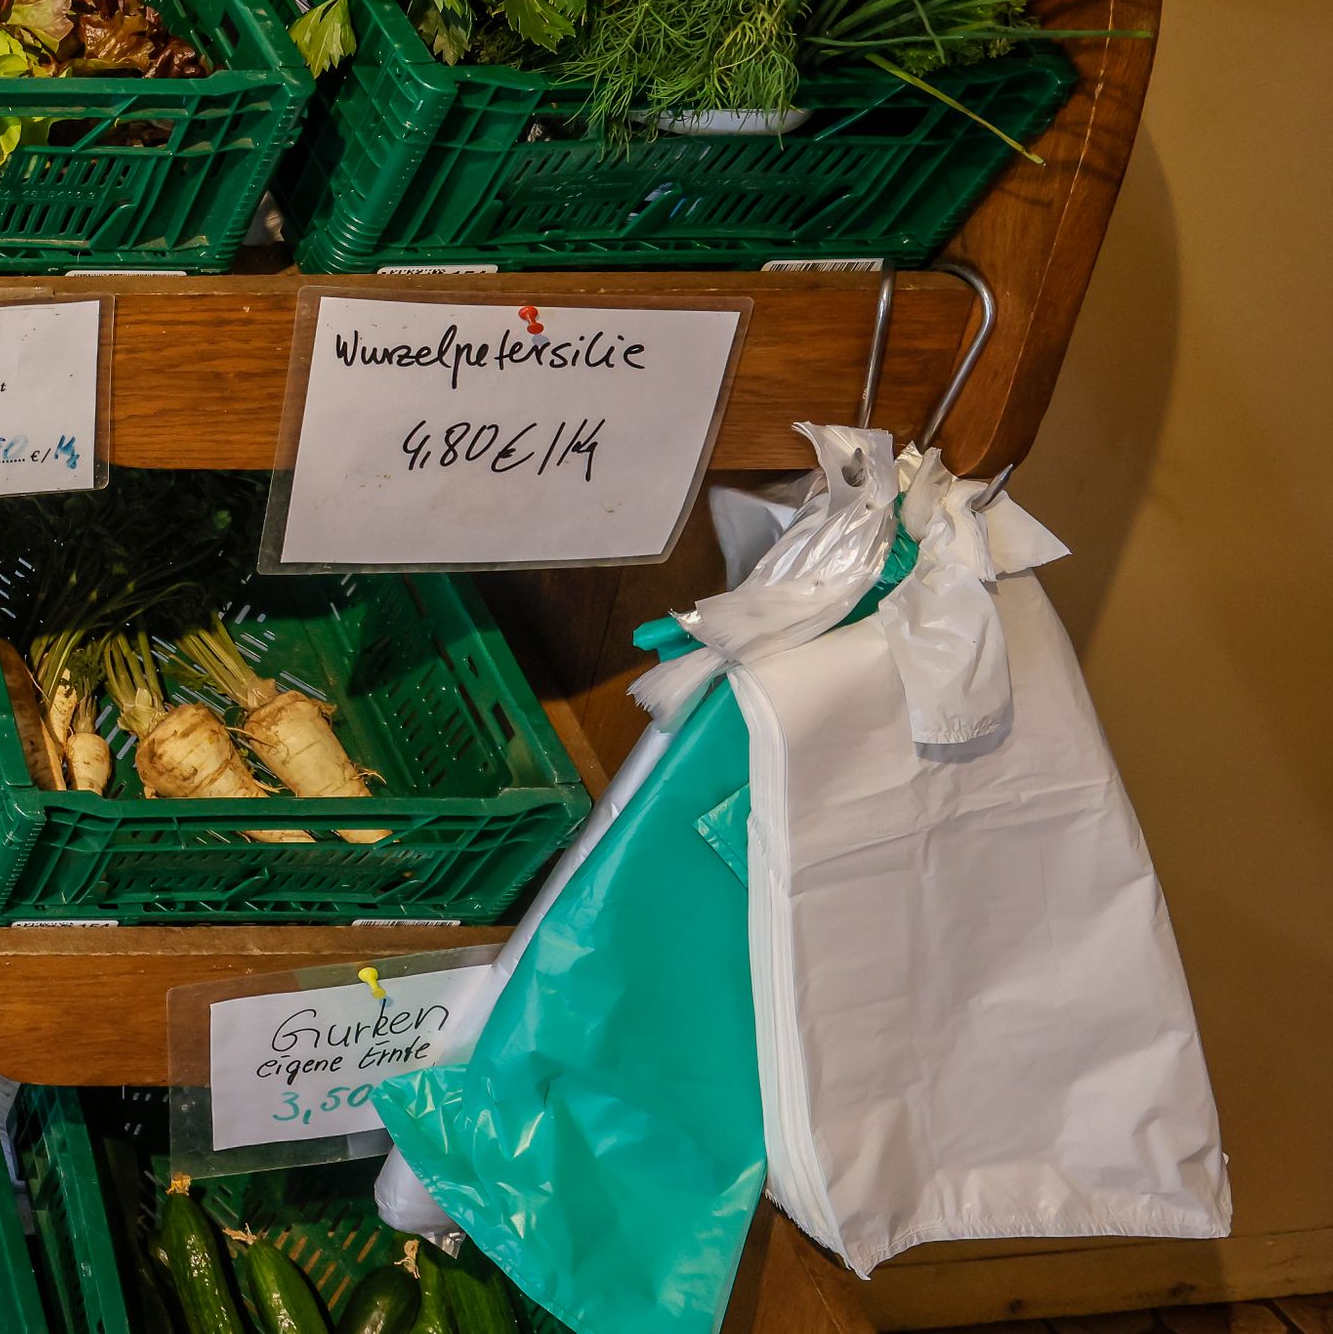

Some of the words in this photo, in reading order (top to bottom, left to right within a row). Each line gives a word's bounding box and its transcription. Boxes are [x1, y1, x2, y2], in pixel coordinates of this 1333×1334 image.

[335, 324, 645, 389] Wurzelpetersilie
[271, 997, 449, 1053] Gurken
[256, 1054, 343, 1085] eigene
[358, 1035, 431, 1070] Ernte
